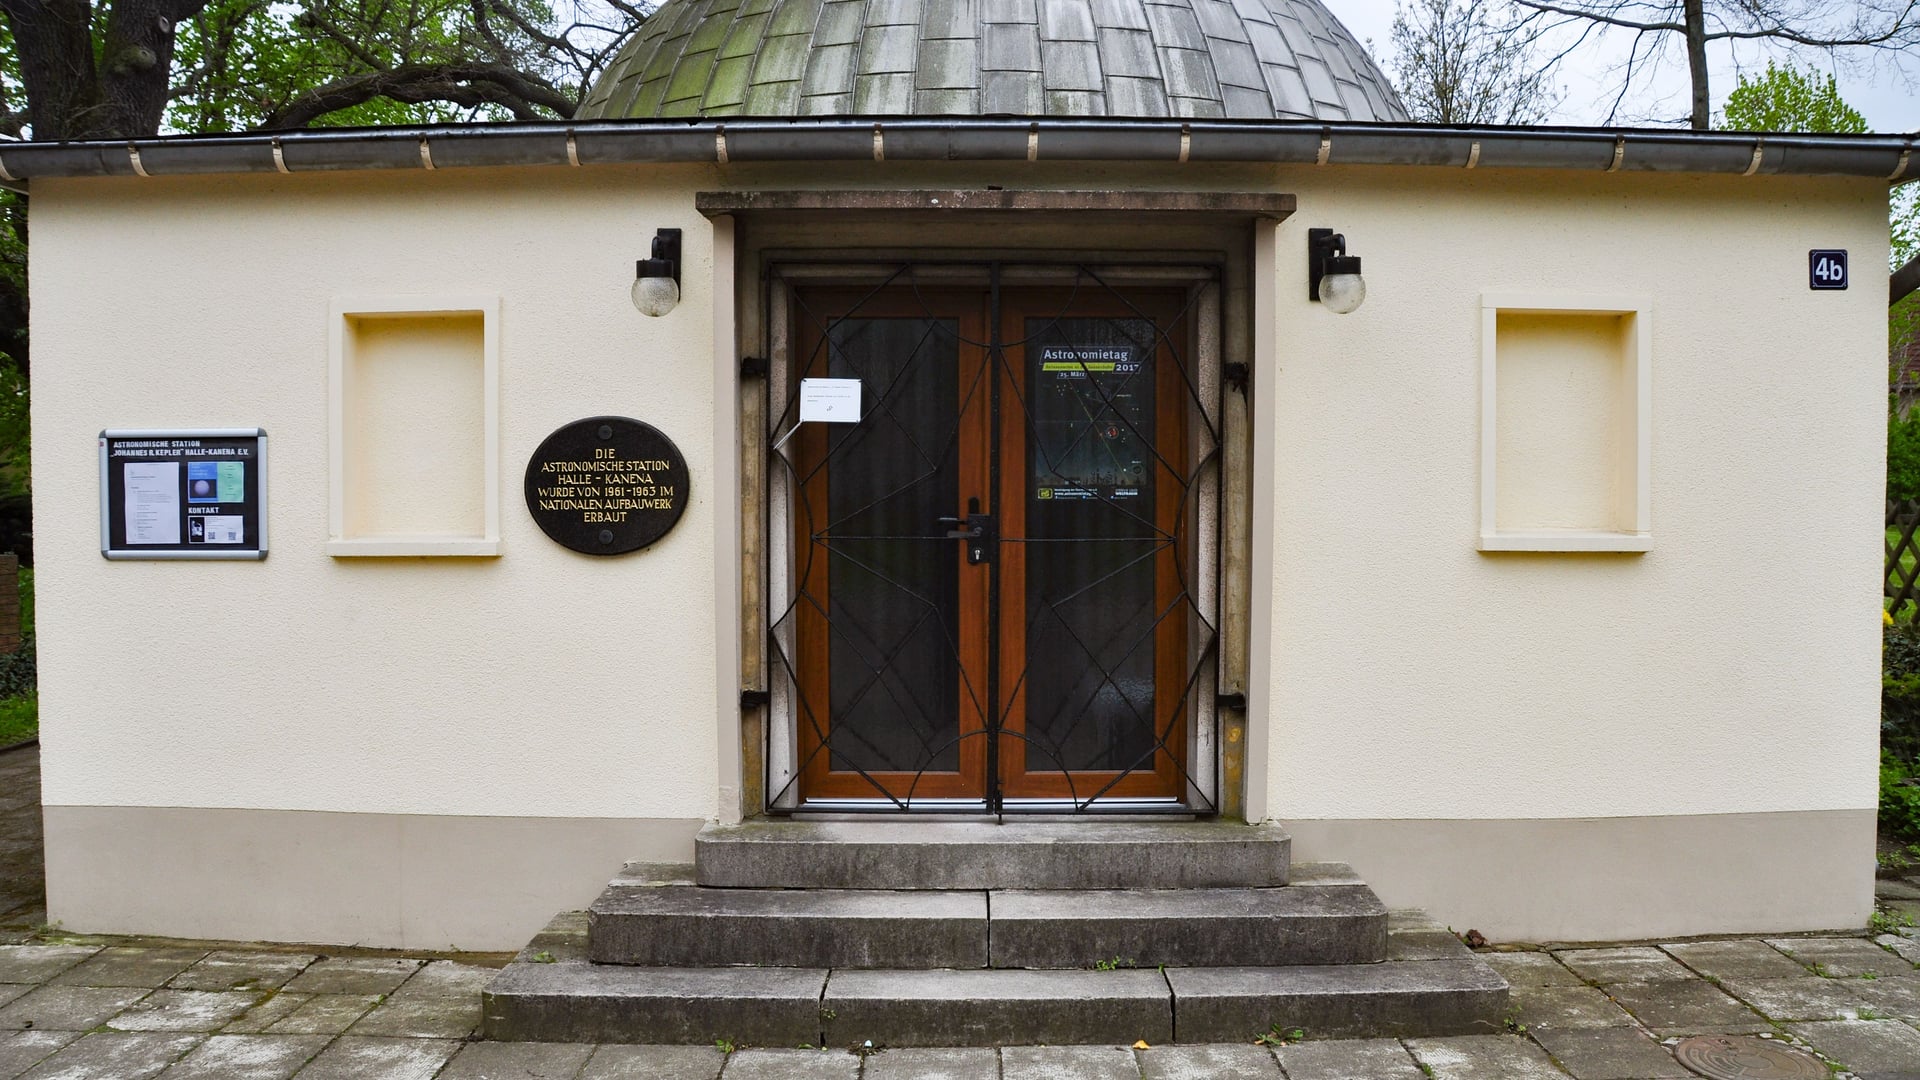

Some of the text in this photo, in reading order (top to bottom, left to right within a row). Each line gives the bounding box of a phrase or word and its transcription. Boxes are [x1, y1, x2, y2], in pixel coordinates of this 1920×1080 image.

[1815, 257, 1843, 281] 4b
[595, 449, 615, 459] DIE
[541, 460, 670, 472] ASTRONOMISCHE STATION
[558, 474, 592, 485] HALLE
[605, 473, 654, 484] KANENA
[538, 487, 576, 497] WURDE
[578, 487, 600, 497] VON
[660, 486, 674, 496] IM
[540, 498, 672, 511] NATIONALEN AUFBAUWERK
[584, 511, 628, 522] ERBAUT
